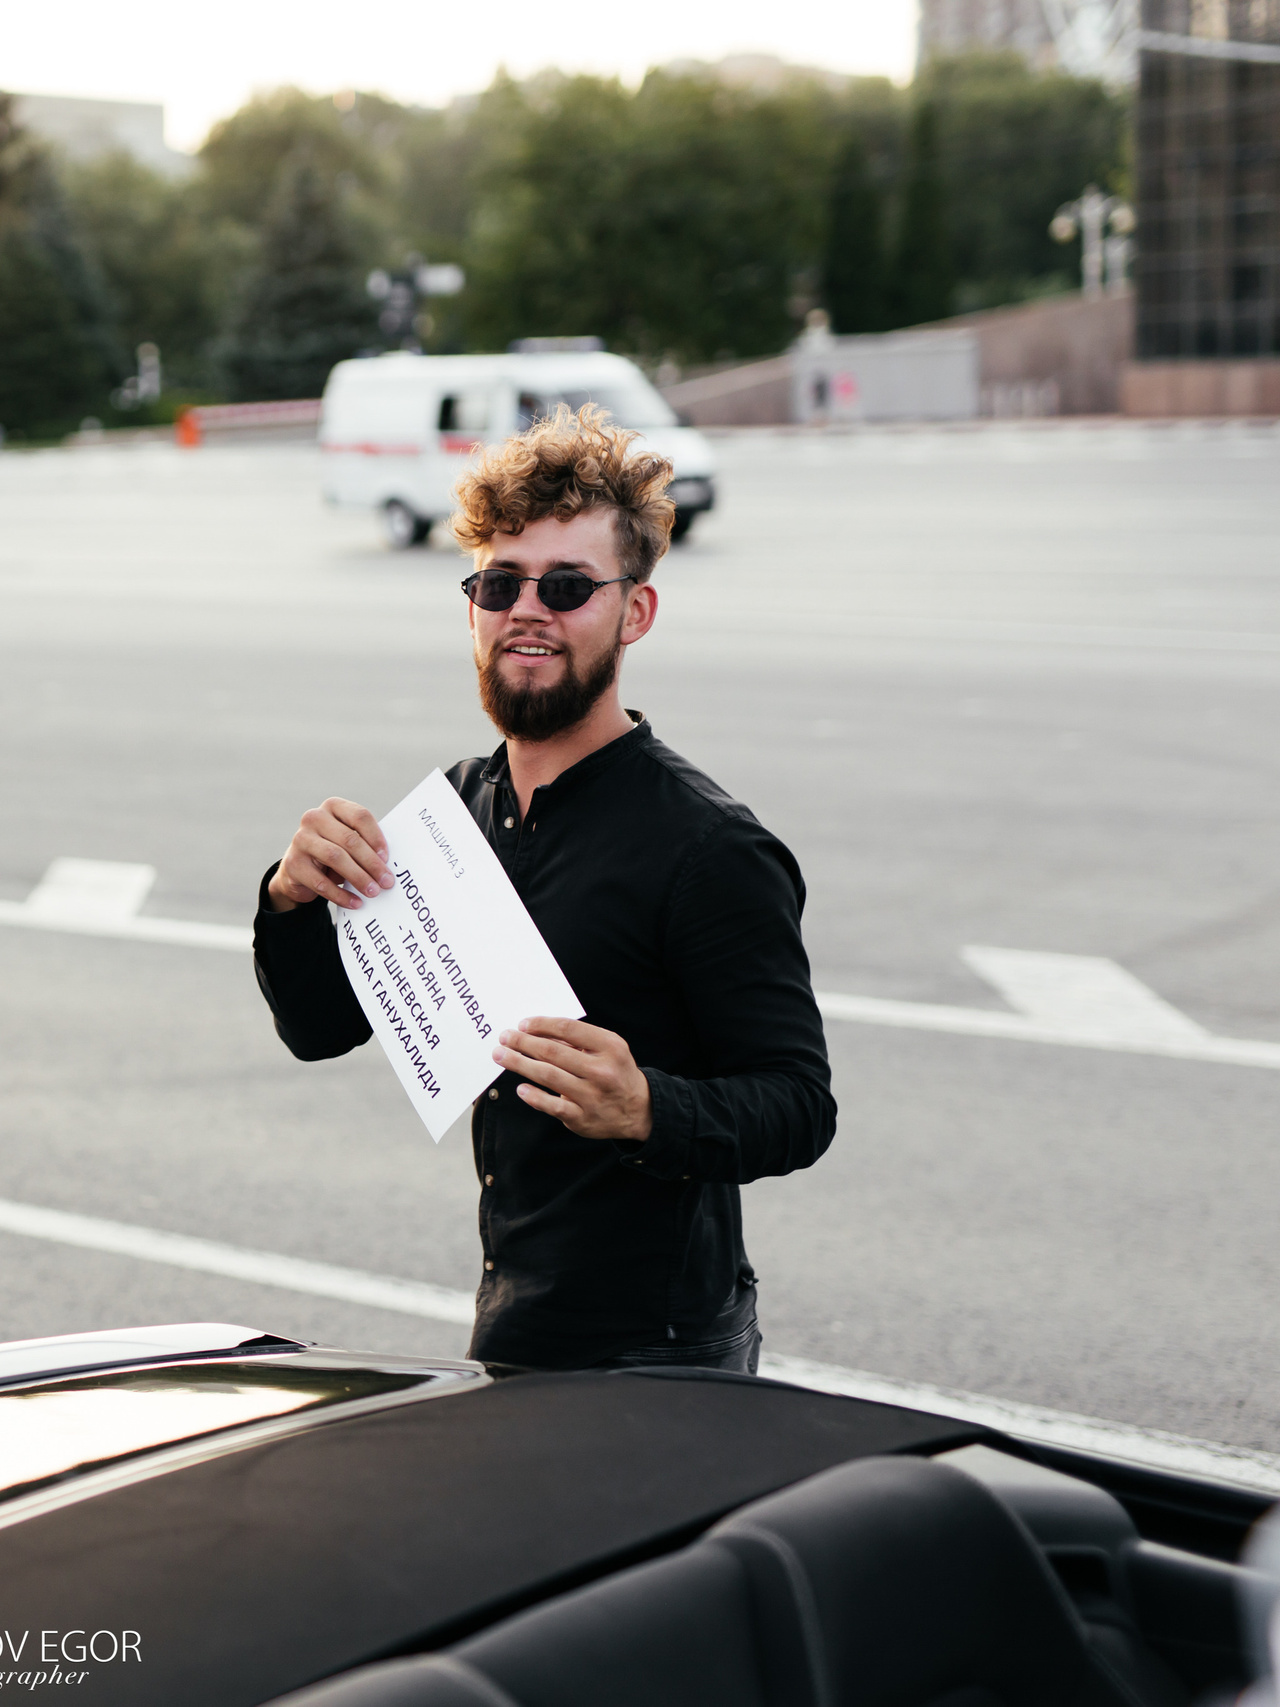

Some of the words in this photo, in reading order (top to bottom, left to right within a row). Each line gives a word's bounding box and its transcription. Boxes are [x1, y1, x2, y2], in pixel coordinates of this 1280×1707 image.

[418, 808, 459, 869] МАШИНА
[455, 867, 465, 879] 3
[343, 919, 375, 982] ДИАНА
[372, 979, 441, 1099] ГАНУХАЛИДИ
[365, 918, 440, 1050] ШЕРШНЕВСКАЯ
[396, 869, 440, 943] ЛЮБОВЬ
[437, 944, 492, 1039] СИПЛИВАЯ
[401, 930, 446, 1011] ТАТЬЯНА
